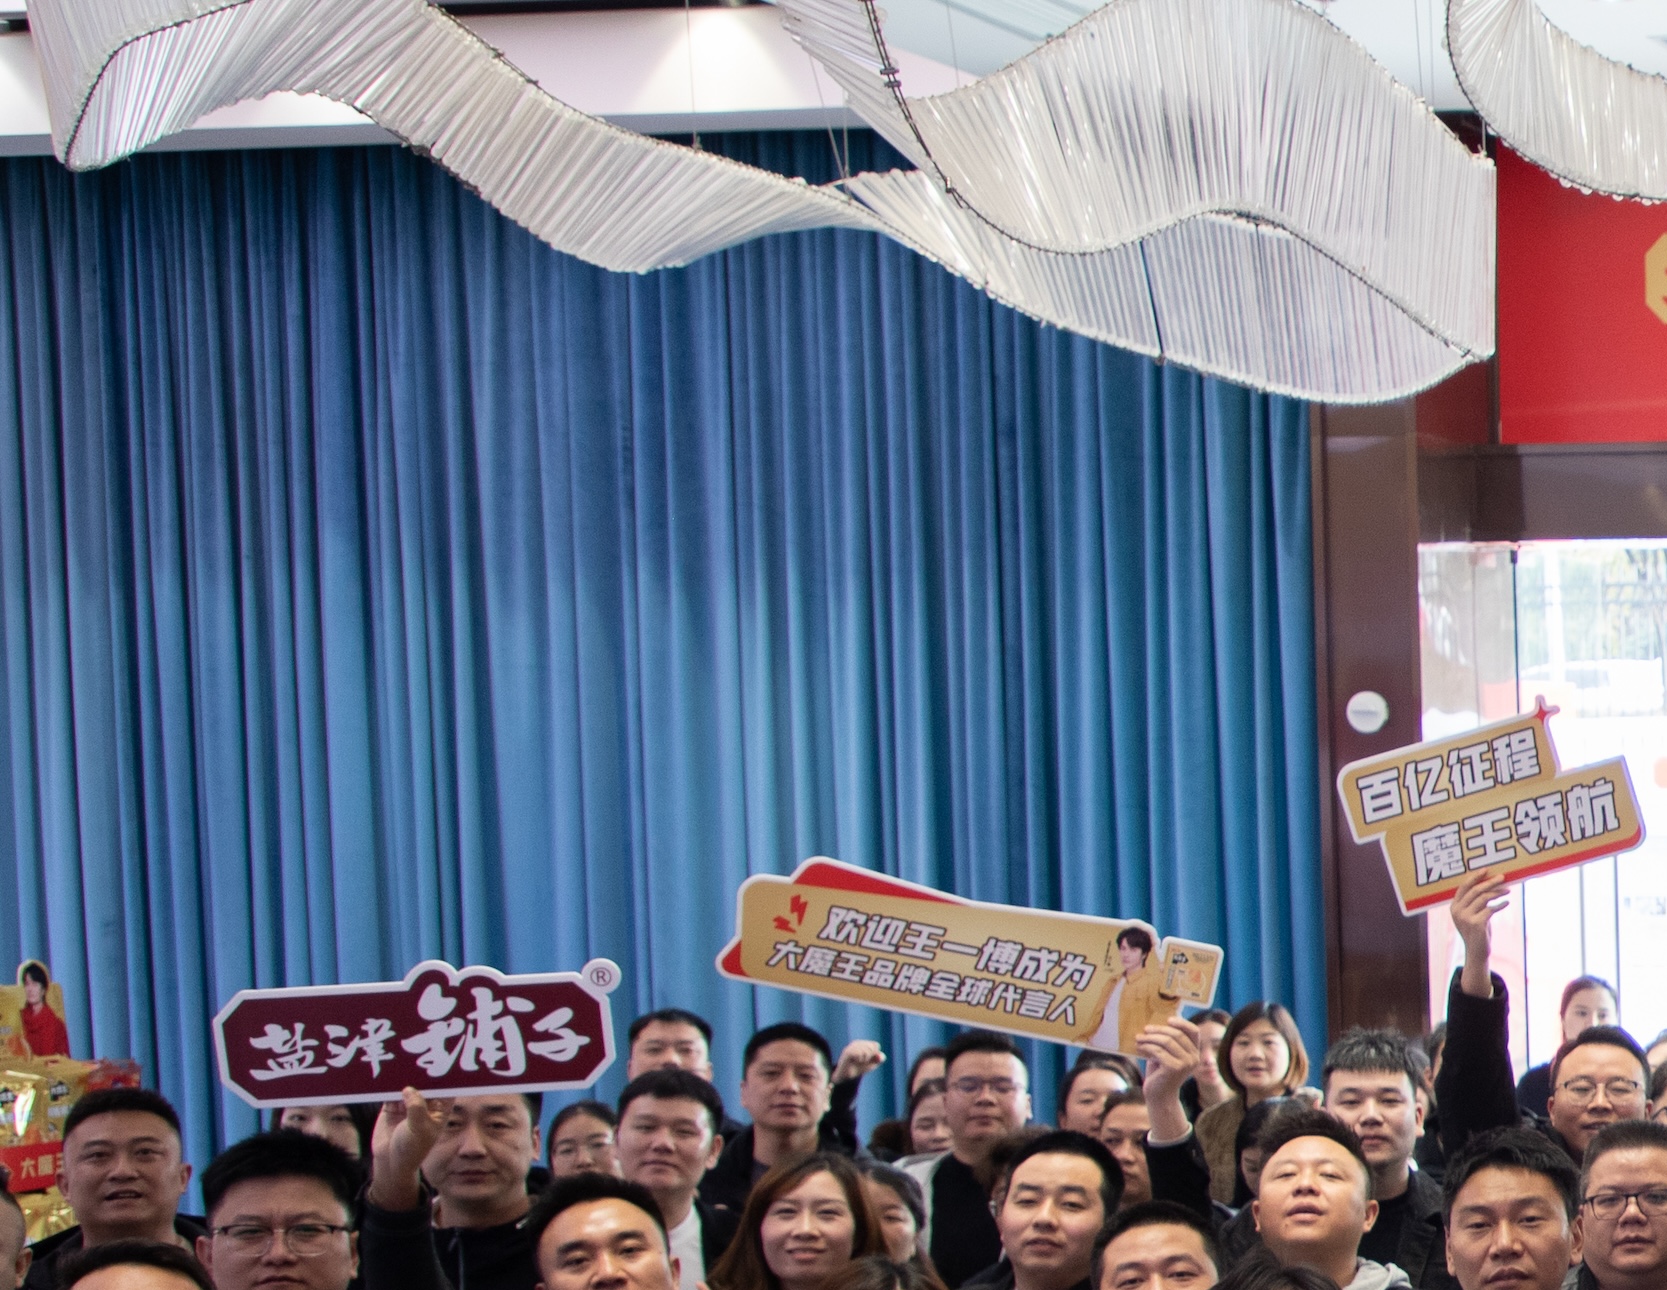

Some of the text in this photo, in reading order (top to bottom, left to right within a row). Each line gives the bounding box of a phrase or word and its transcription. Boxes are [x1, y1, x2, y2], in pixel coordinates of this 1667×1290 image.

[1356, 727, 1542, 825] 百亿征程
[1411, 778, 1621, 887] 魔王领航
[769, 940, 1078, 1027] 大魔王品牌全球代言人
[819, 905, 1096, 993] 欢迎王一博成为
[248, 984, 591, 1077] 盐津铺子
